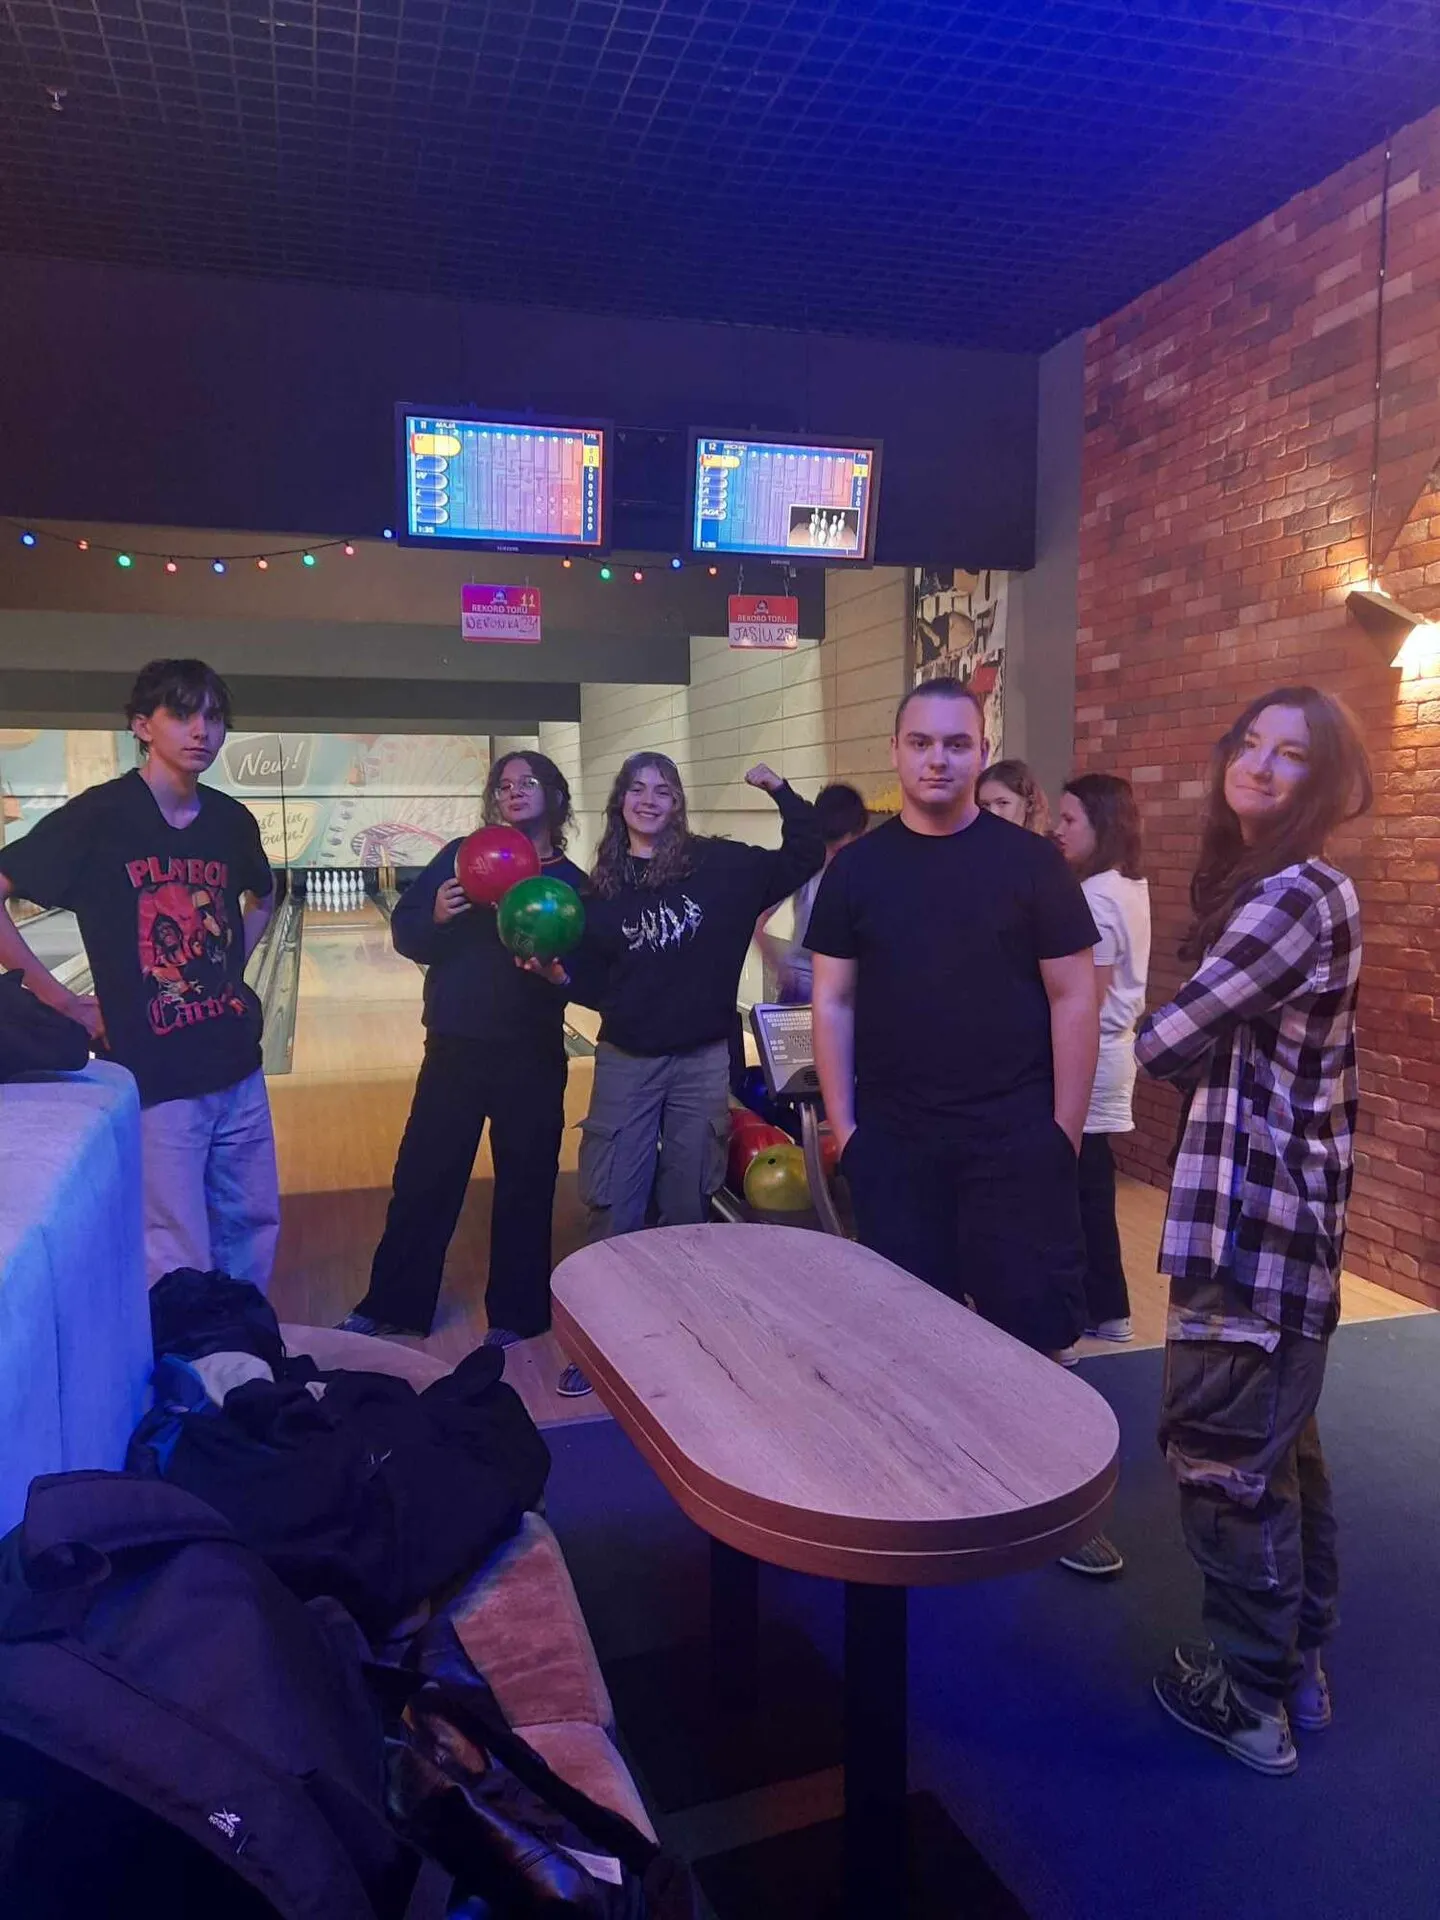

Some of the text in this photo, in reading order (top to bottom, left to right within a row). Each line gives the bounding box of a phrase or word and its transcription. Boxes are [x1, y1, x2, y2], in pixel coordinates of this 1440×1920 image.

[520, 593, 536, 608] 11
[472, 603, 528, 614] REKORD TORU
[737, 614, 787, 623] REKORD TORU
[237, 741, 304, 781] New!
